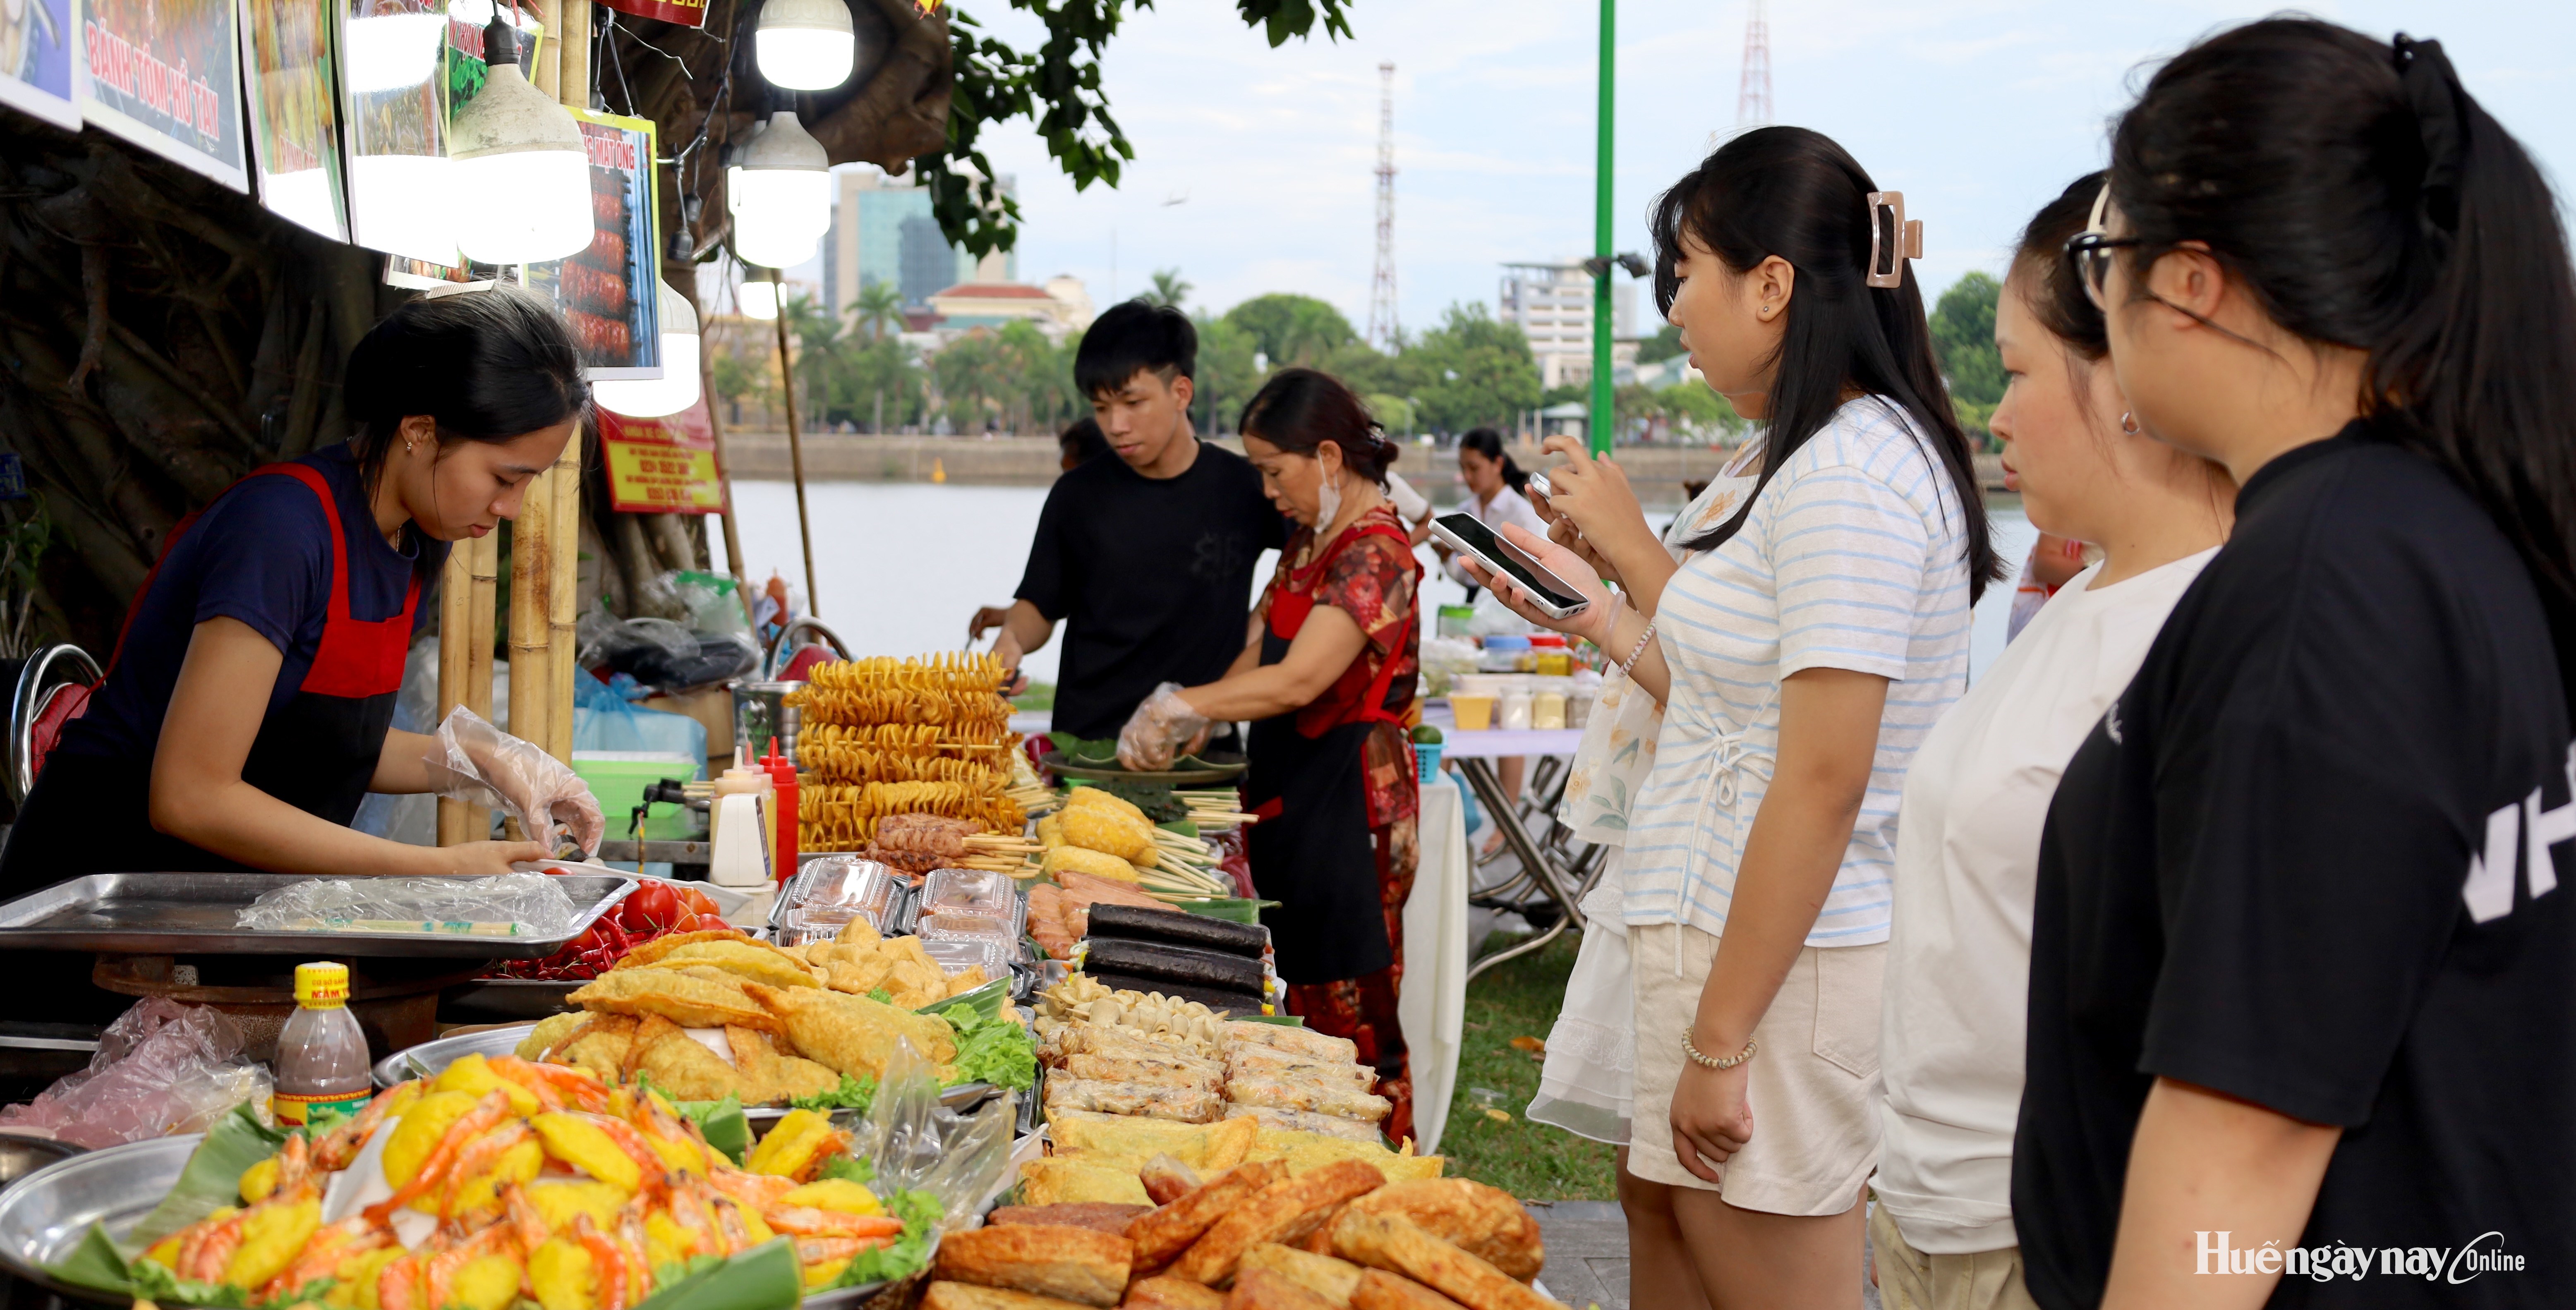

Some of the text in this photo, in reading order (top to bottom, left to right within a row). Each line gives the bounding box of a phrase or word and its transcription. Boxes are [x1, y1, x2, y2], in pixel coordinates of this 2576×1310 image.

[86, 17, 219, 141] BÁNH TÔM HỒ TÂY
[595, 132, 615, 174] MẬT
[616, 140, 635, 170] ONG
